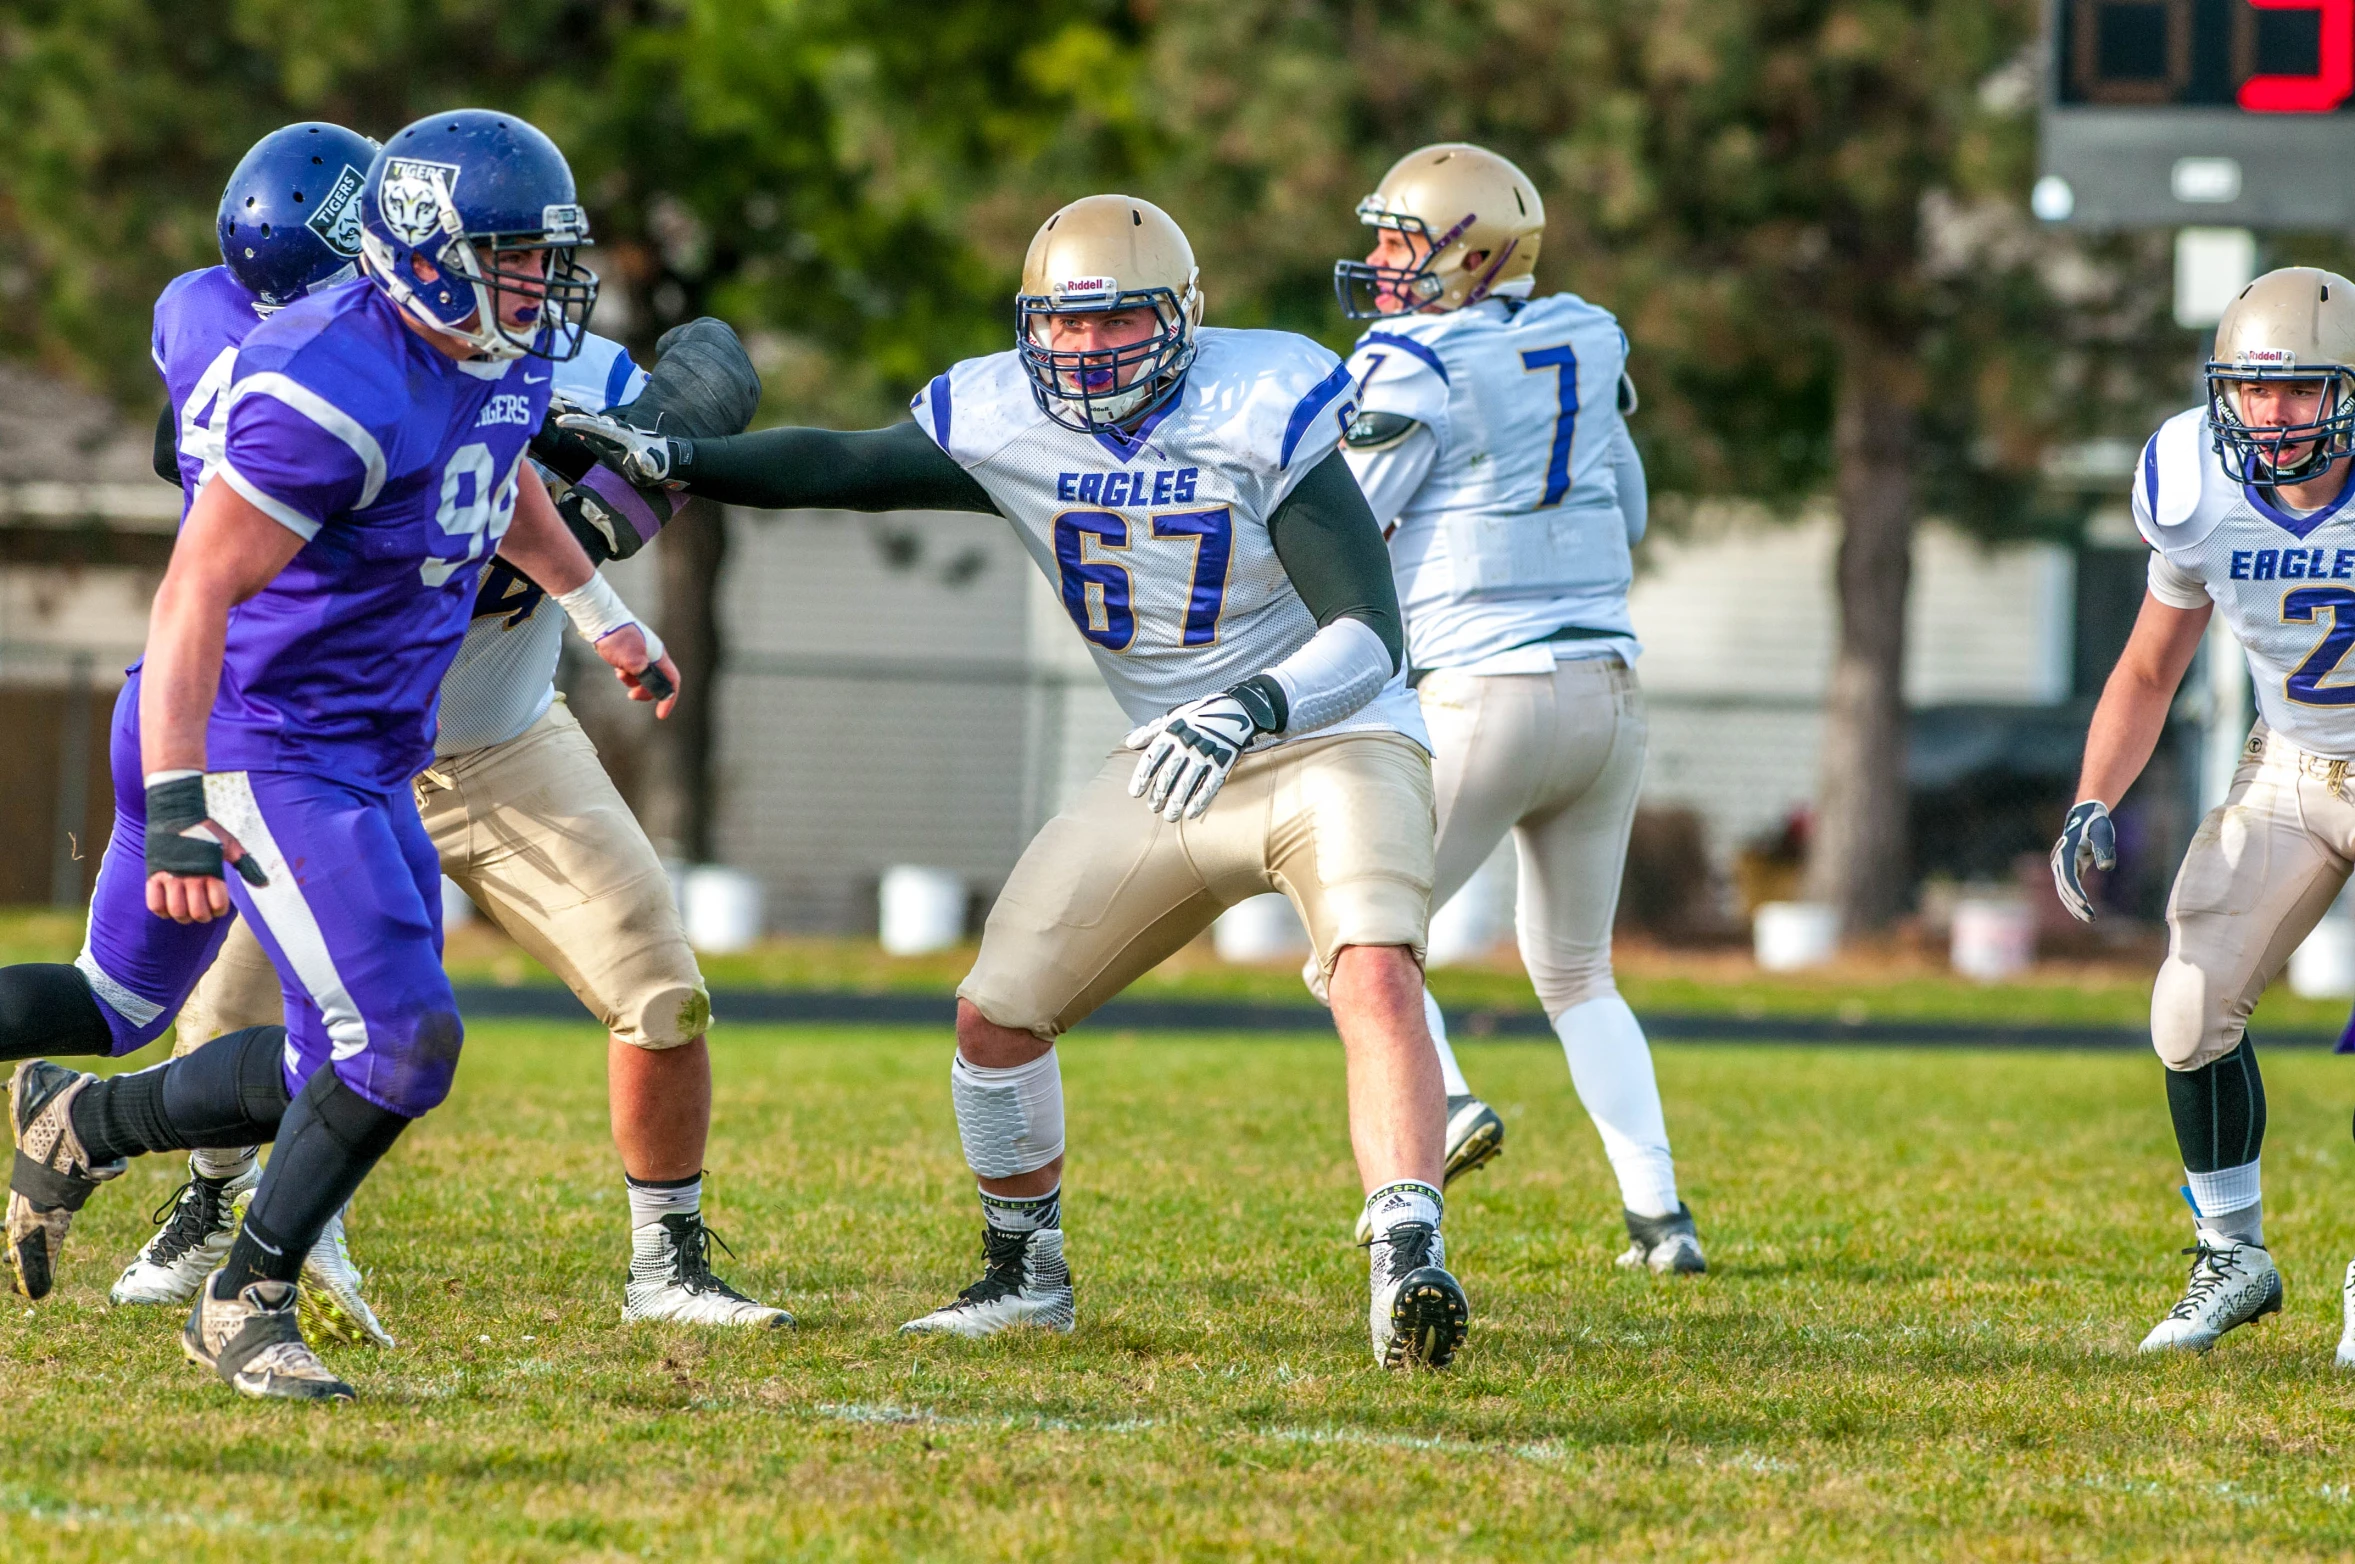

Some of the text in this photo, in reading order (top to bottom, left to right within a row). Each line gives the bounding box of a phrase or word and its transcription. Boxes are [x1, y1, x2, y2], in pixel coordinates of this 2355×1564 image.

[317, 176, 355, 224] TIGERS
[1067, 279, 1103, 291] Riddell
[2249, 350, 2282, 361] Riddell
[474, 394, 530, 428] IGERS
[1517, 341, 1580, 511] 7
[1057, 467, 1199, 507] EAGLES
[419, 438, 531, 588] 94
[1050, 503, 1237, 655] 67
[2229, 548, 2355, 581] EAGLE
[2279, 583, 2355, 709] 2
